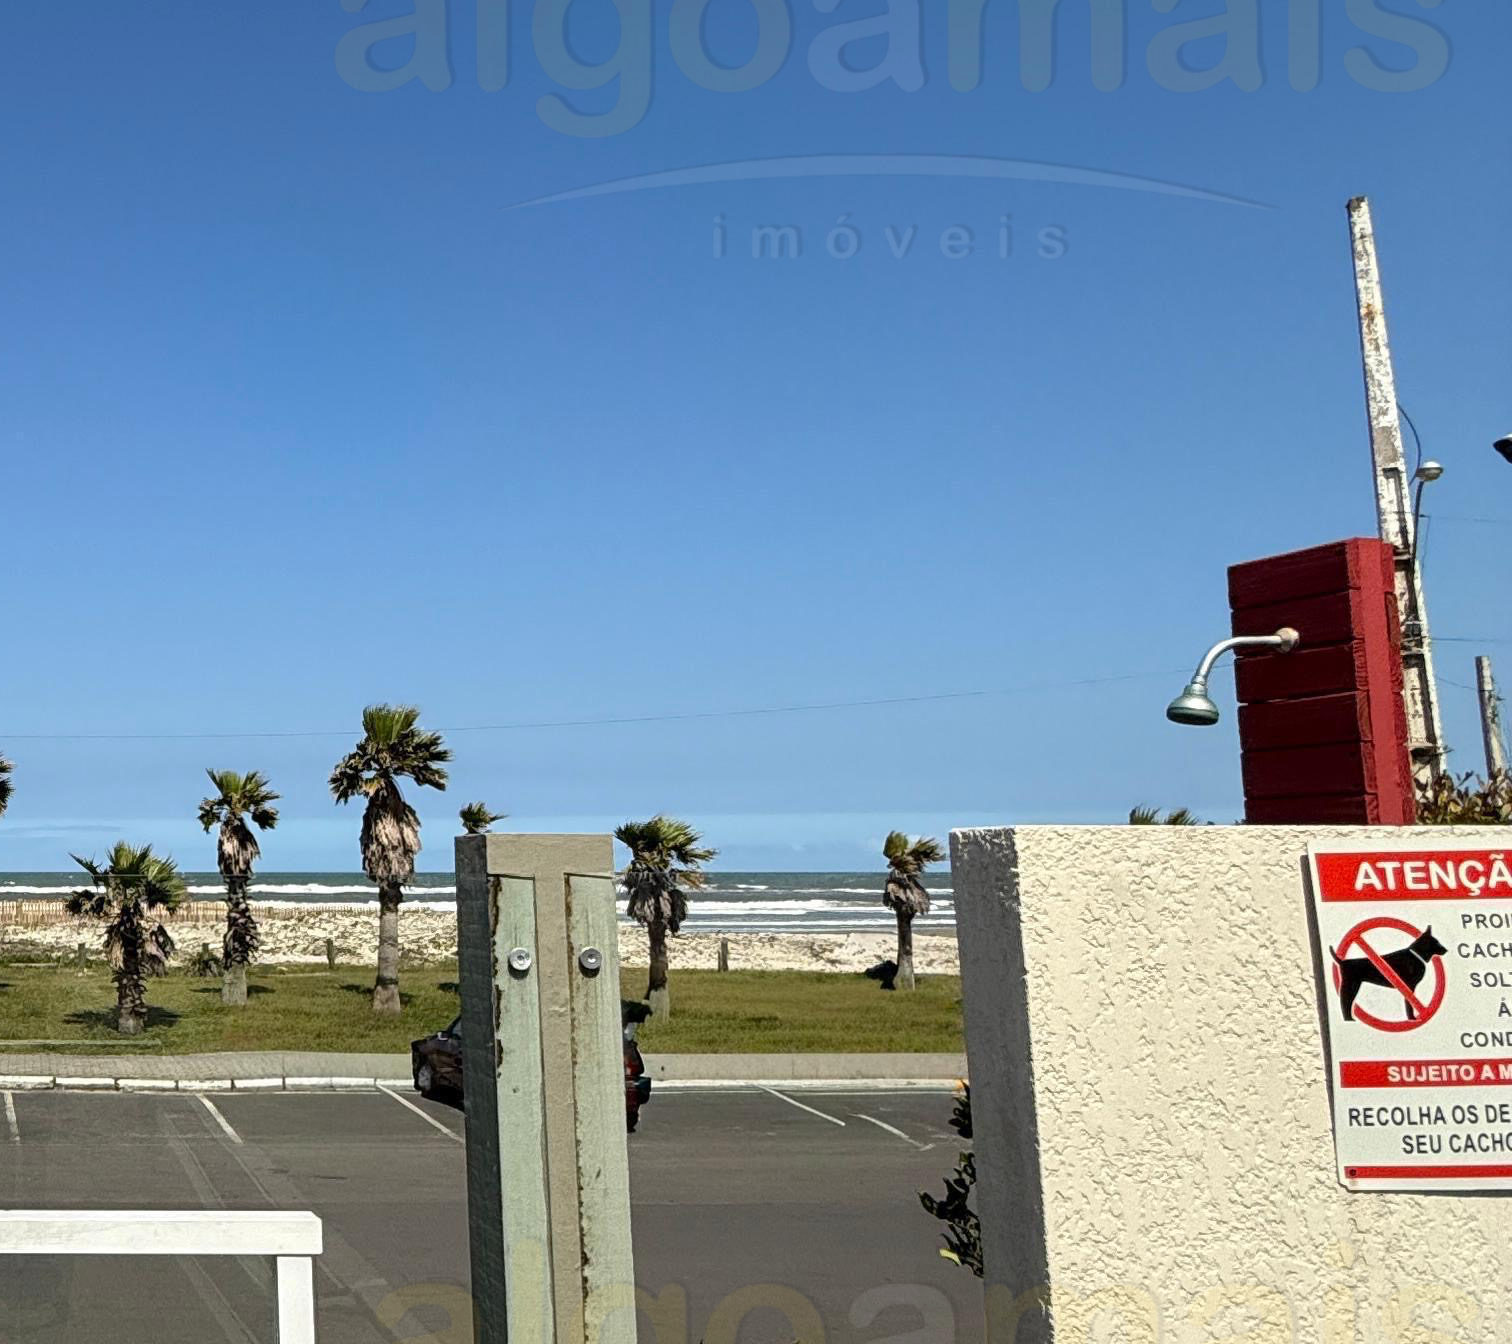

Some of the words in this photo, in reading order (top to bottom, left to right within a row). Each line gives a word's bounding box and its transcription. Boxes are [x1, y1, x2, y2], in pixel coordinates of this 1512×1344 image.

[1354, 853, 1512, 896] ATENÇÃ
[1461, 913, 1512, 929] PROI
[1470, 972, 1512, 987] SOL
[1387, 1064, 1476, 1082] SUJEITO
[1480, 1064, 1496, 1080] A
[1348, 1105, 1447, 1127] RECOLHA
[1452, 1104, 1479, 1124] OS
[1402, 1134, 1442, 1154] SEU
